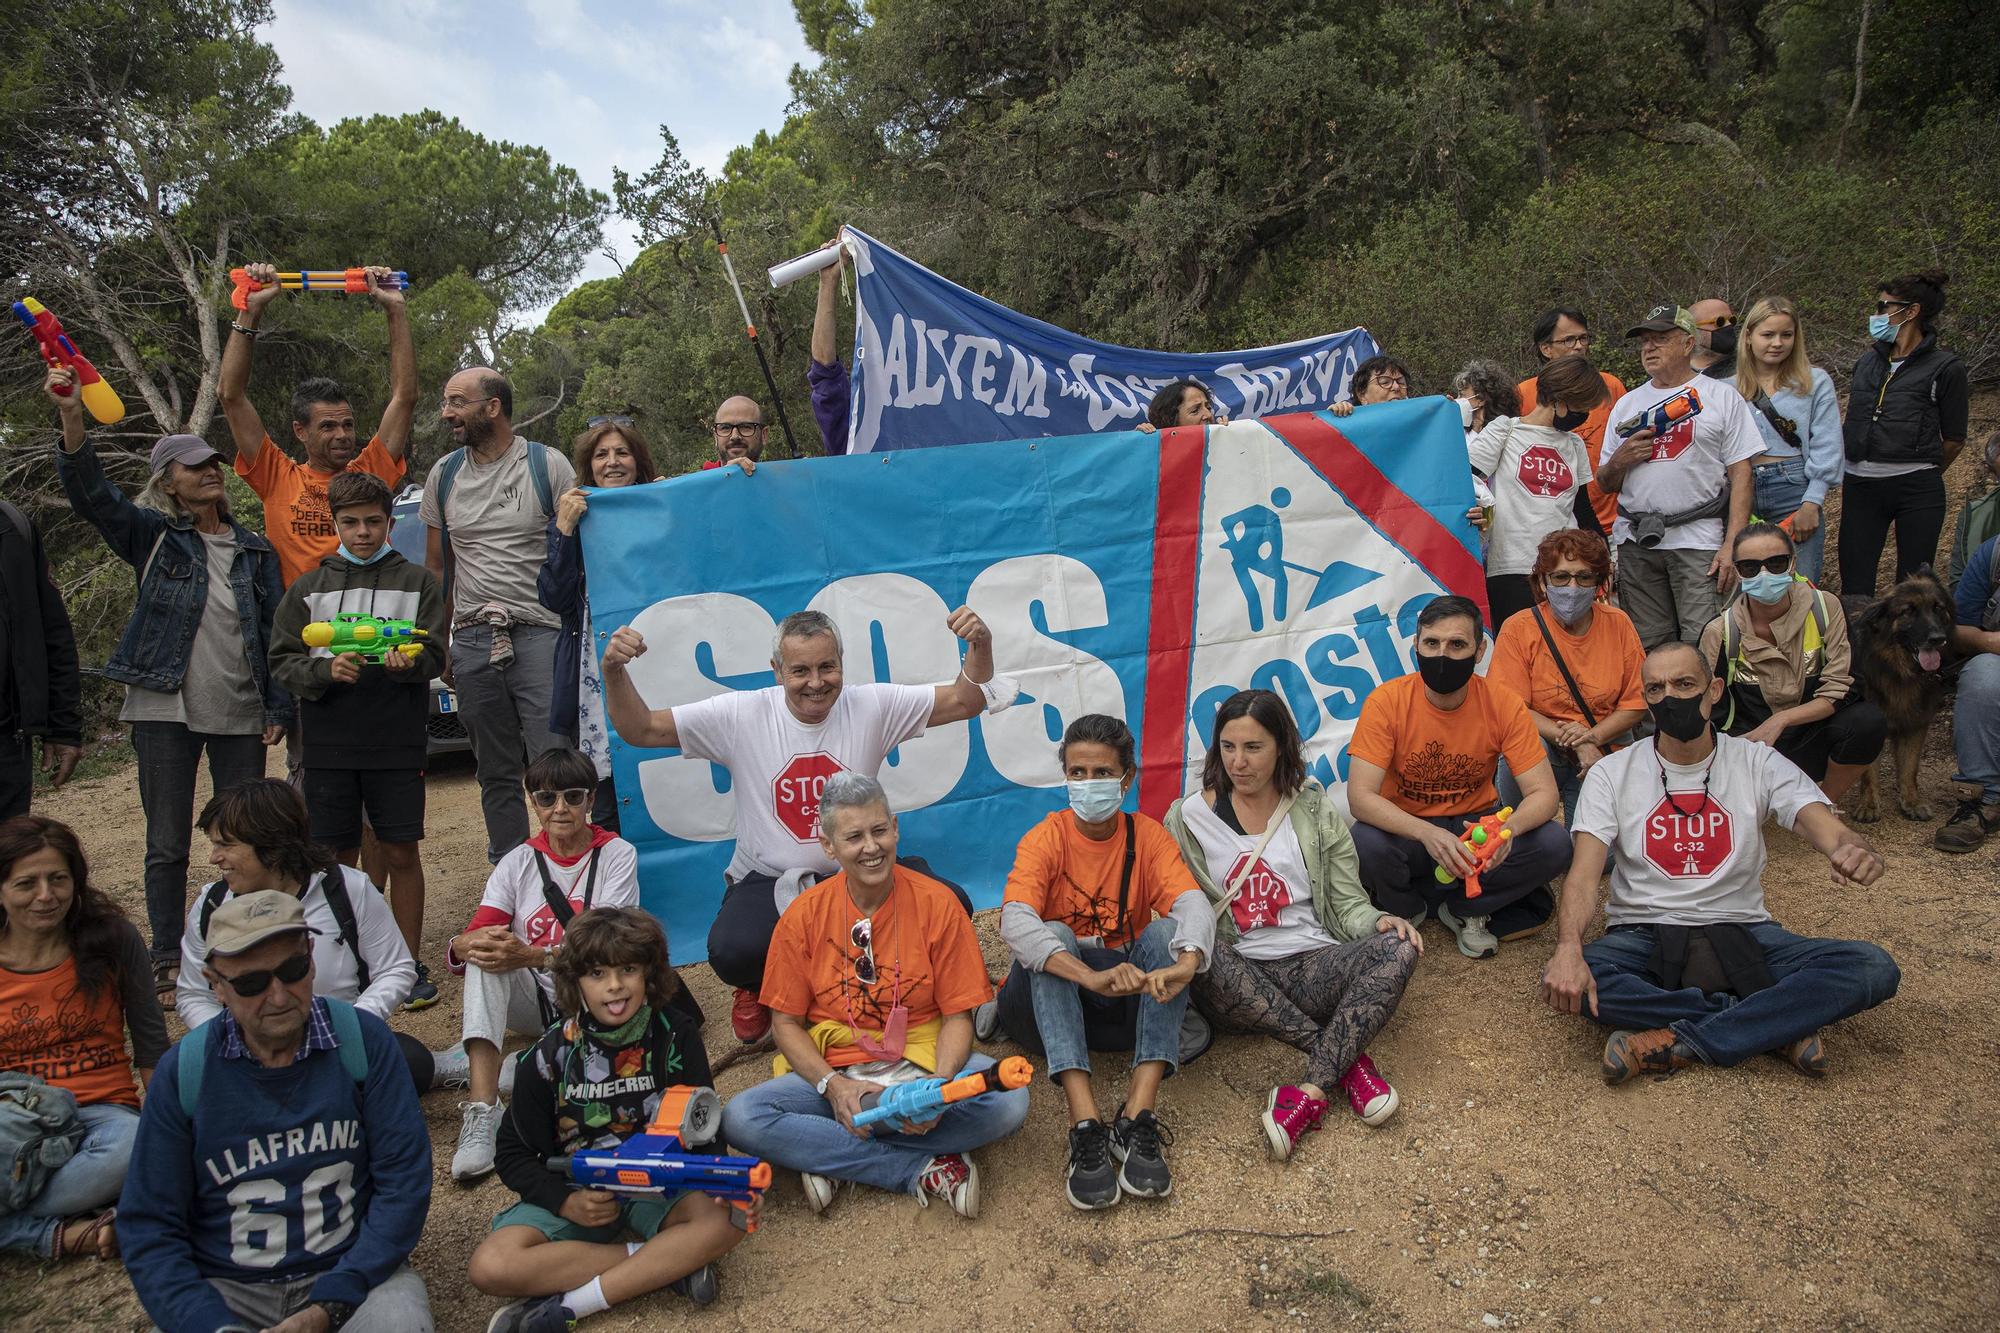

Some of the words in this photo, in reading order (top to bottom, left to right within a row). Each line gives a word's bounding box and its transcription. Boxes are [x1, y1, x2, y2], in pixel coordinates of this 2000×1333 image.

[1214, 345, 1359, 421] BRAVA
[1653, 435, 1673, 445] C-32
[1524, 456, 1567, 476] STOP
[1537, 473, 1557, 483] C-32
[296, 510, 331, 522] DEFE
[628, 553, 1127, 842] SOS
[780, 775, 828, 804] STO
[801, 804, 820, 816] C-3
[1651, 812, 1724, 840] STOP
[1673, 841, 1705, 852] C-32
[205, 1119, 359, 1186] LLAFRANC
[226, 1160, 356, 1268] 60
